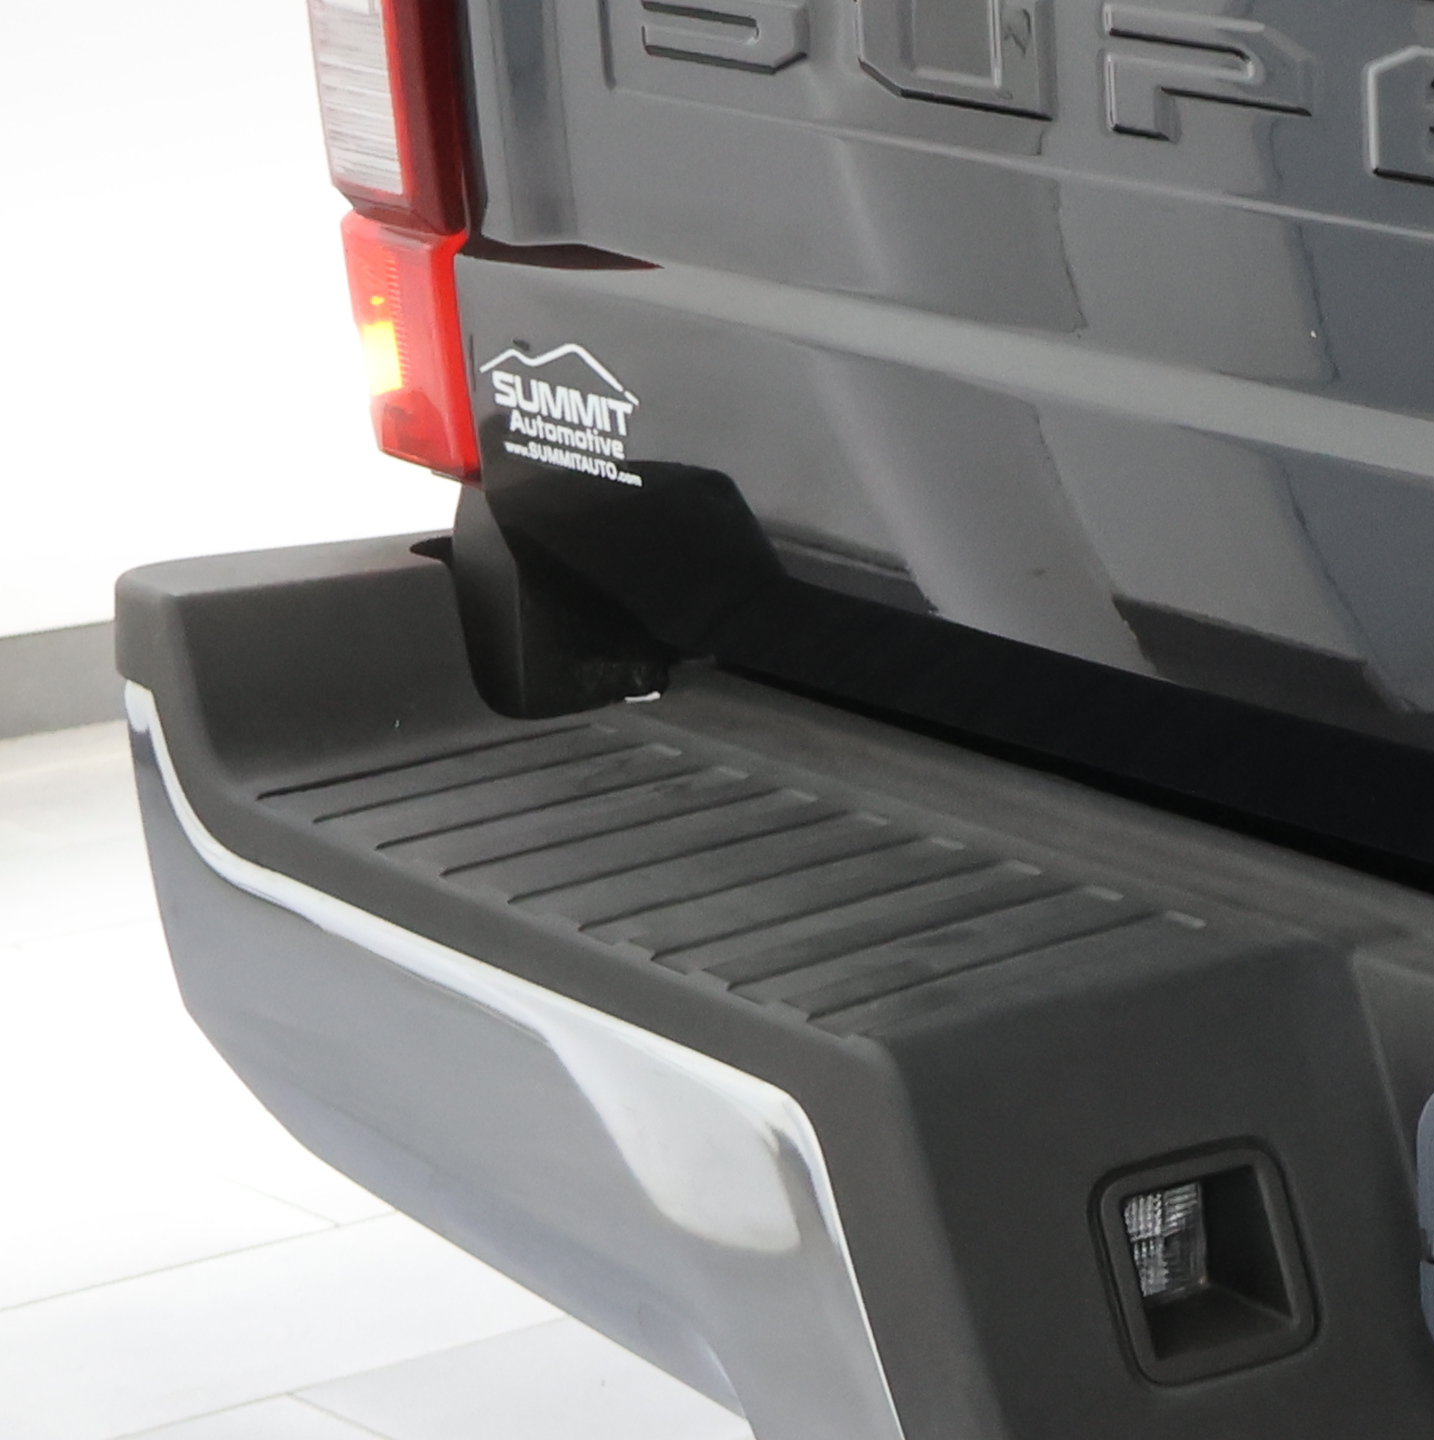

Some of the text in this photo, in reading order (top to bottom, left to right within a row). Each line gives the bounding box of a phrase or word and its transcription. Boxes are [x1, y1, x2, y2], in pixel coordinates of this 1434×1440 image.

[492, 370, 633, 436] SUMMIT
[509, 410, 626, 459] Automotive
[504, 441, 643, 487] www.SUMMITAUTO.com
